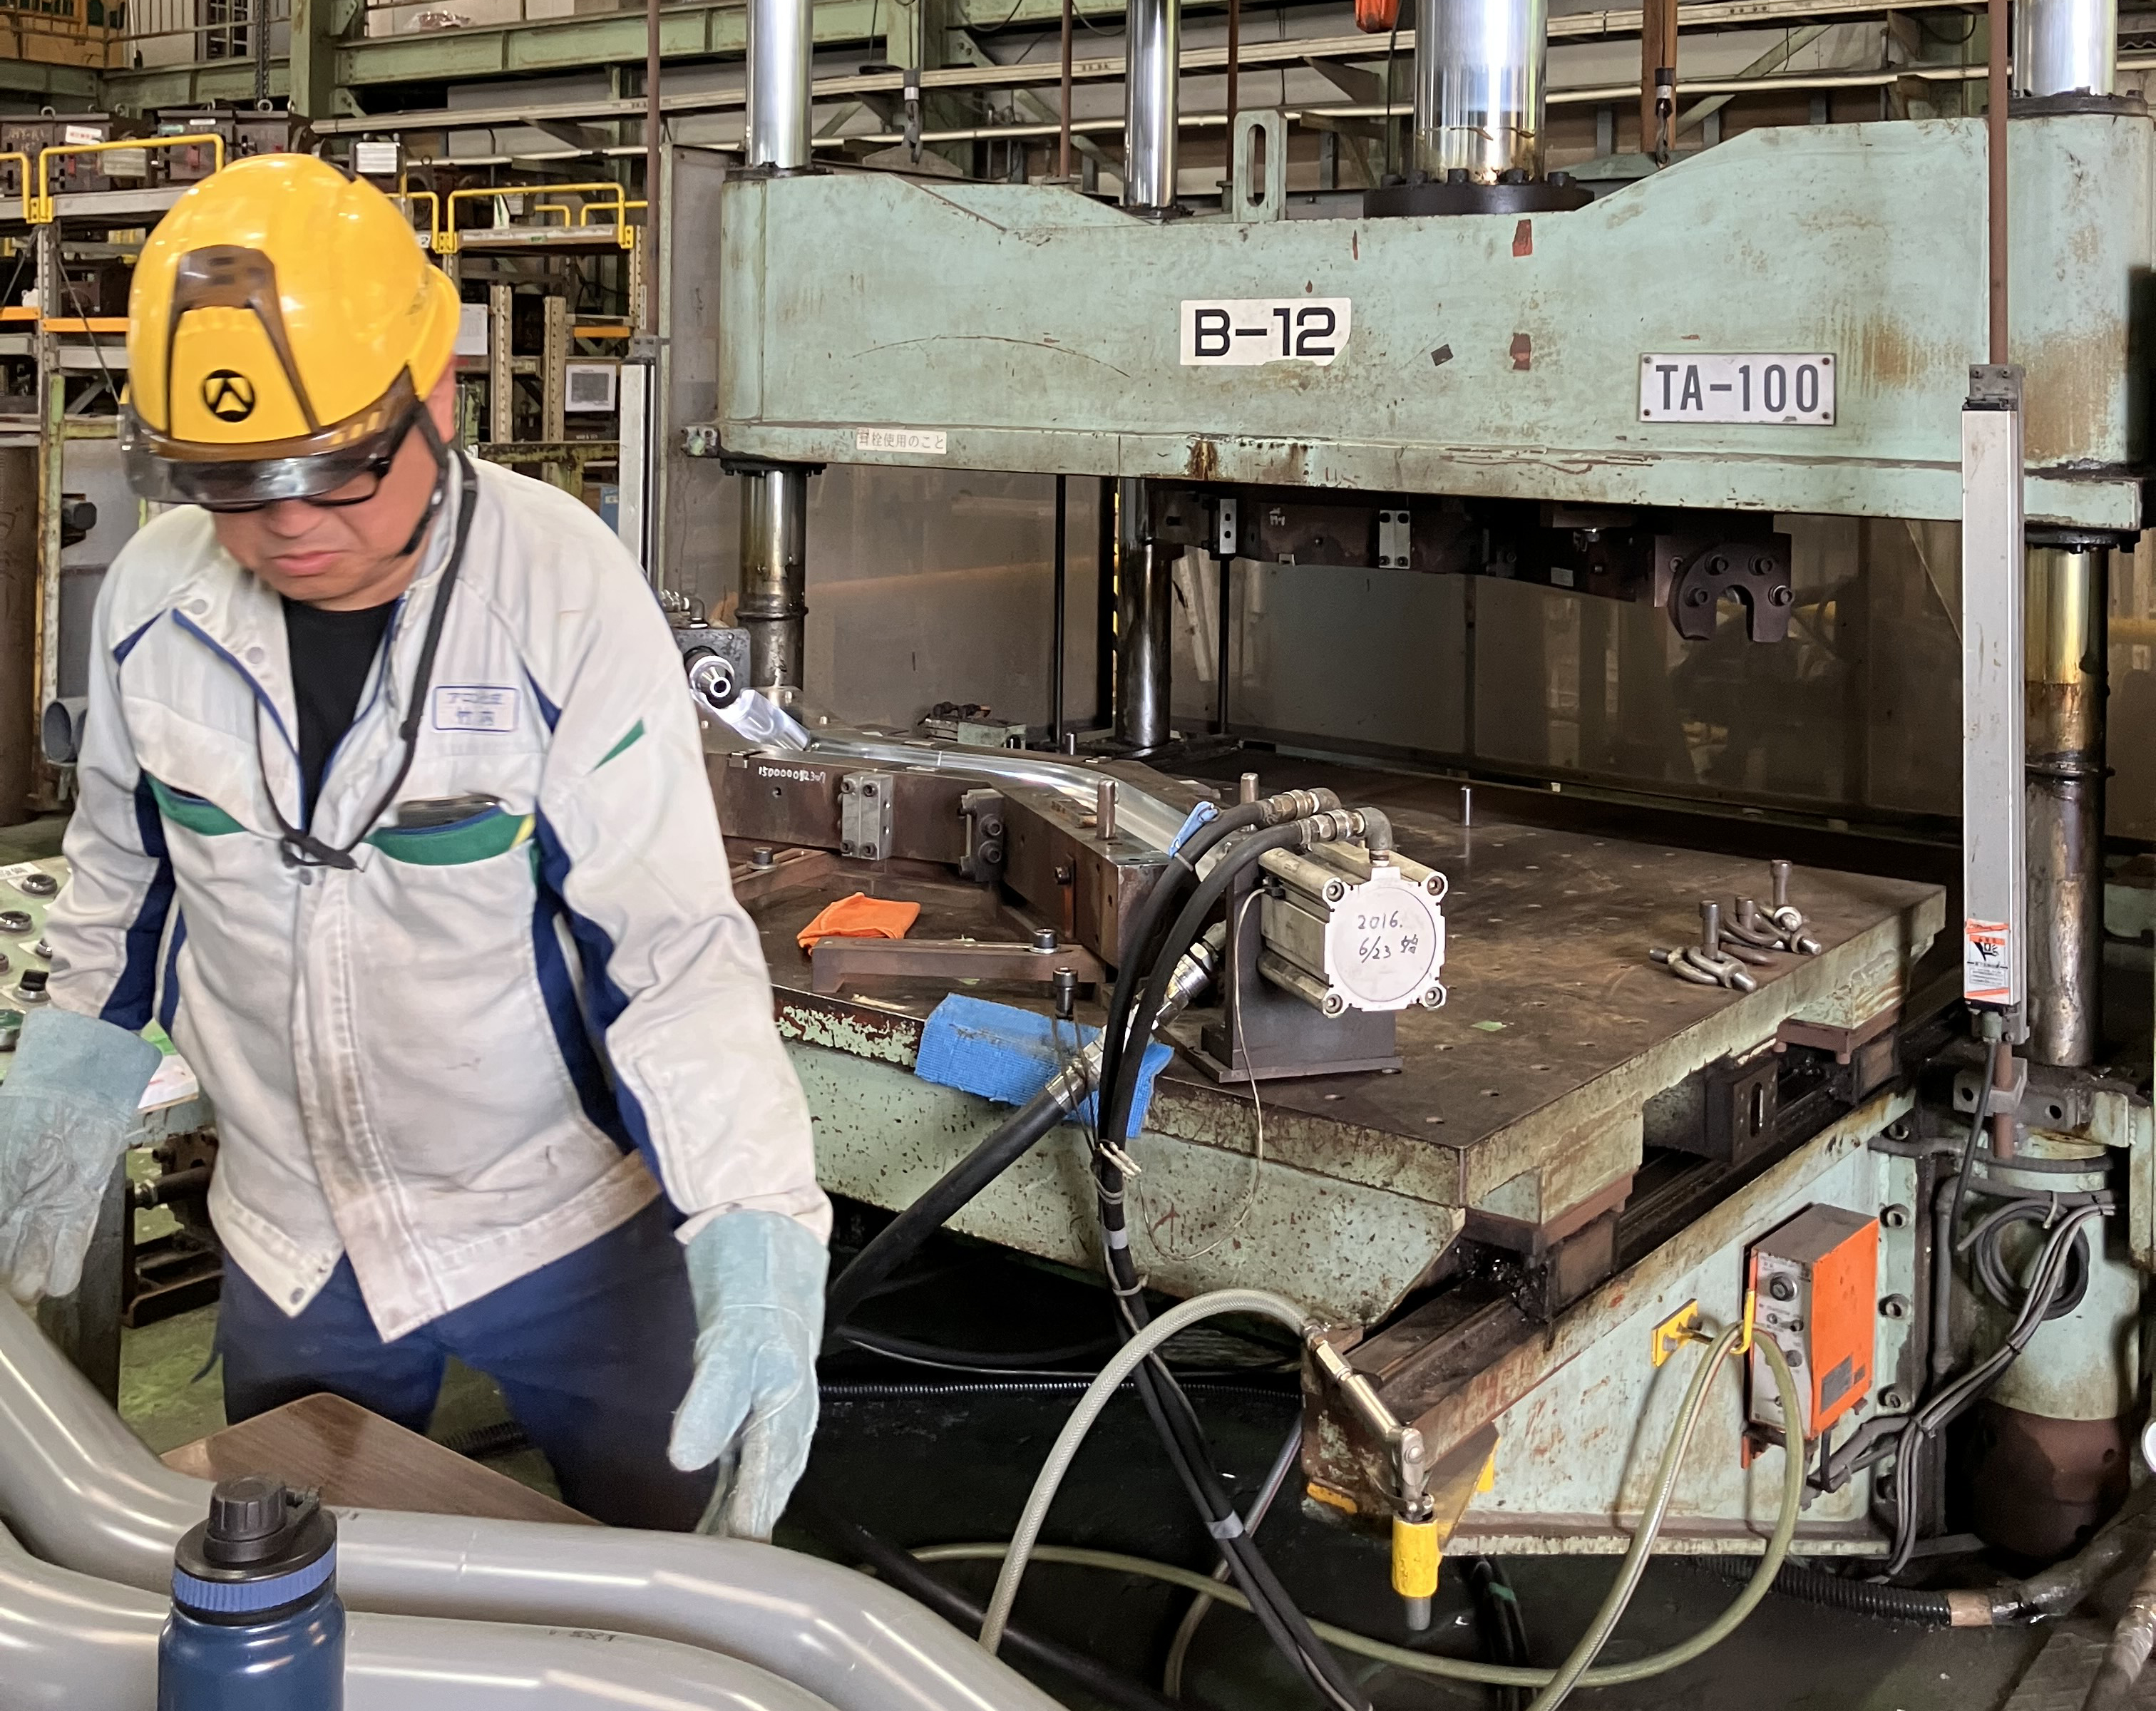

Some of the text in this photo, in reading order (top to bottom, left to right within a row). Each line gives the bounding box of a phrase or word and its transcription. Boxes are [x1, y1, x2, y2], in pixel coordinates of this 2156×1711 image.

[1195, 307, 1335, 356] B-12
[1655, 364, 1819, 413] TA-100
[1358, 935, 1392, 964] 6/23
